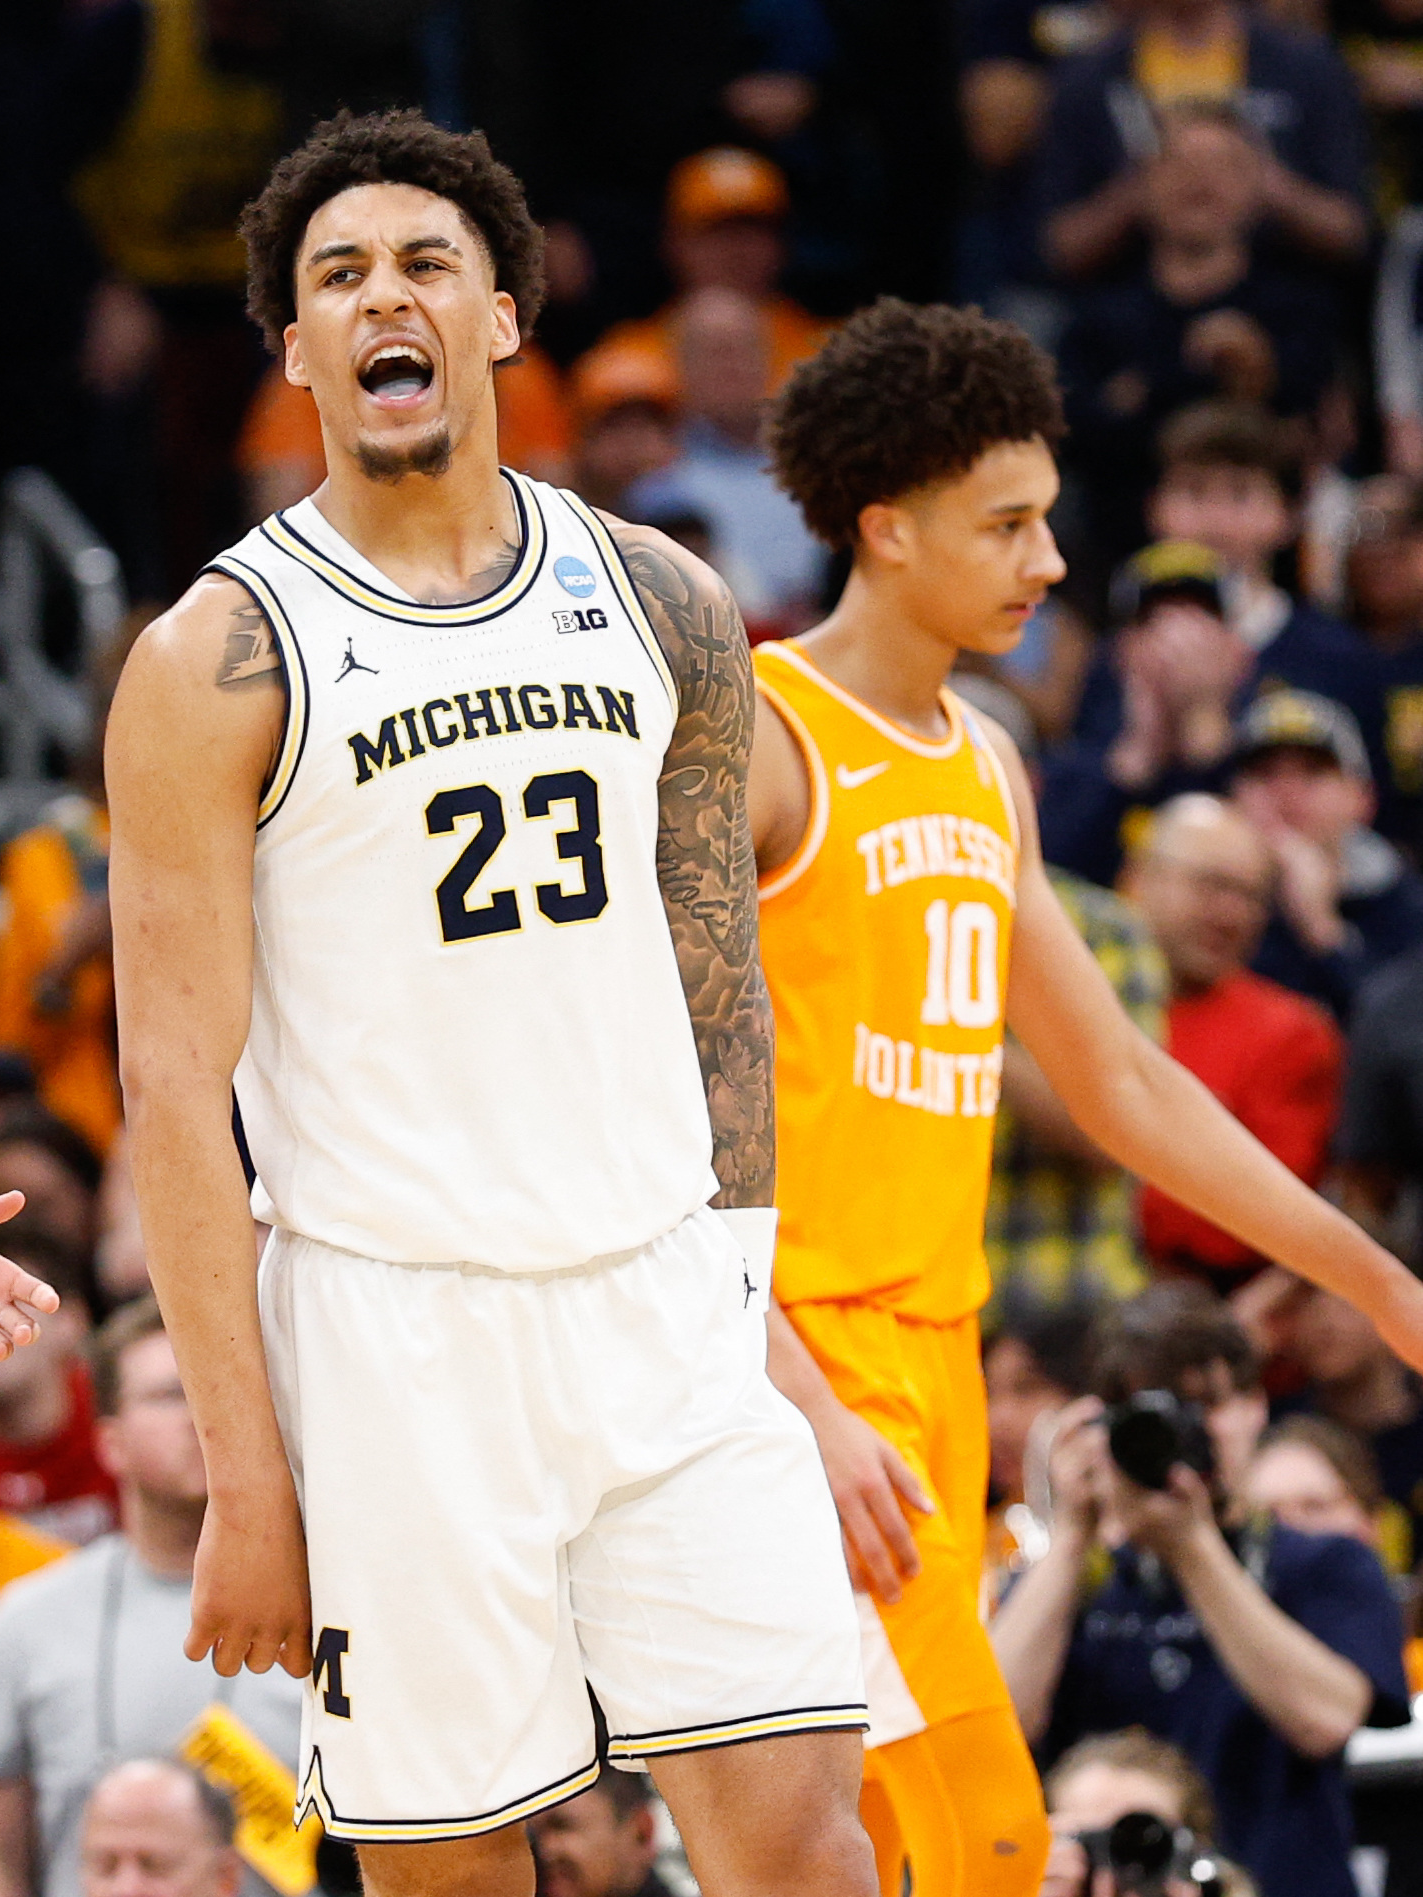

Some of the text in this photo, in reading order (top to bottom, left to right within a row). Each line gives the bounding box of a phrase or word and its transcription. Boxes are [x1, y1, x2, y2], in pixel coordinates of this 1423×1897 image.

[562, 574, 595, 588] NCAA
[347, 683, 641, 786] MICHIGAN
[425, 767, 609, 945] 23
[920, 898, 1000, 1030] 10
